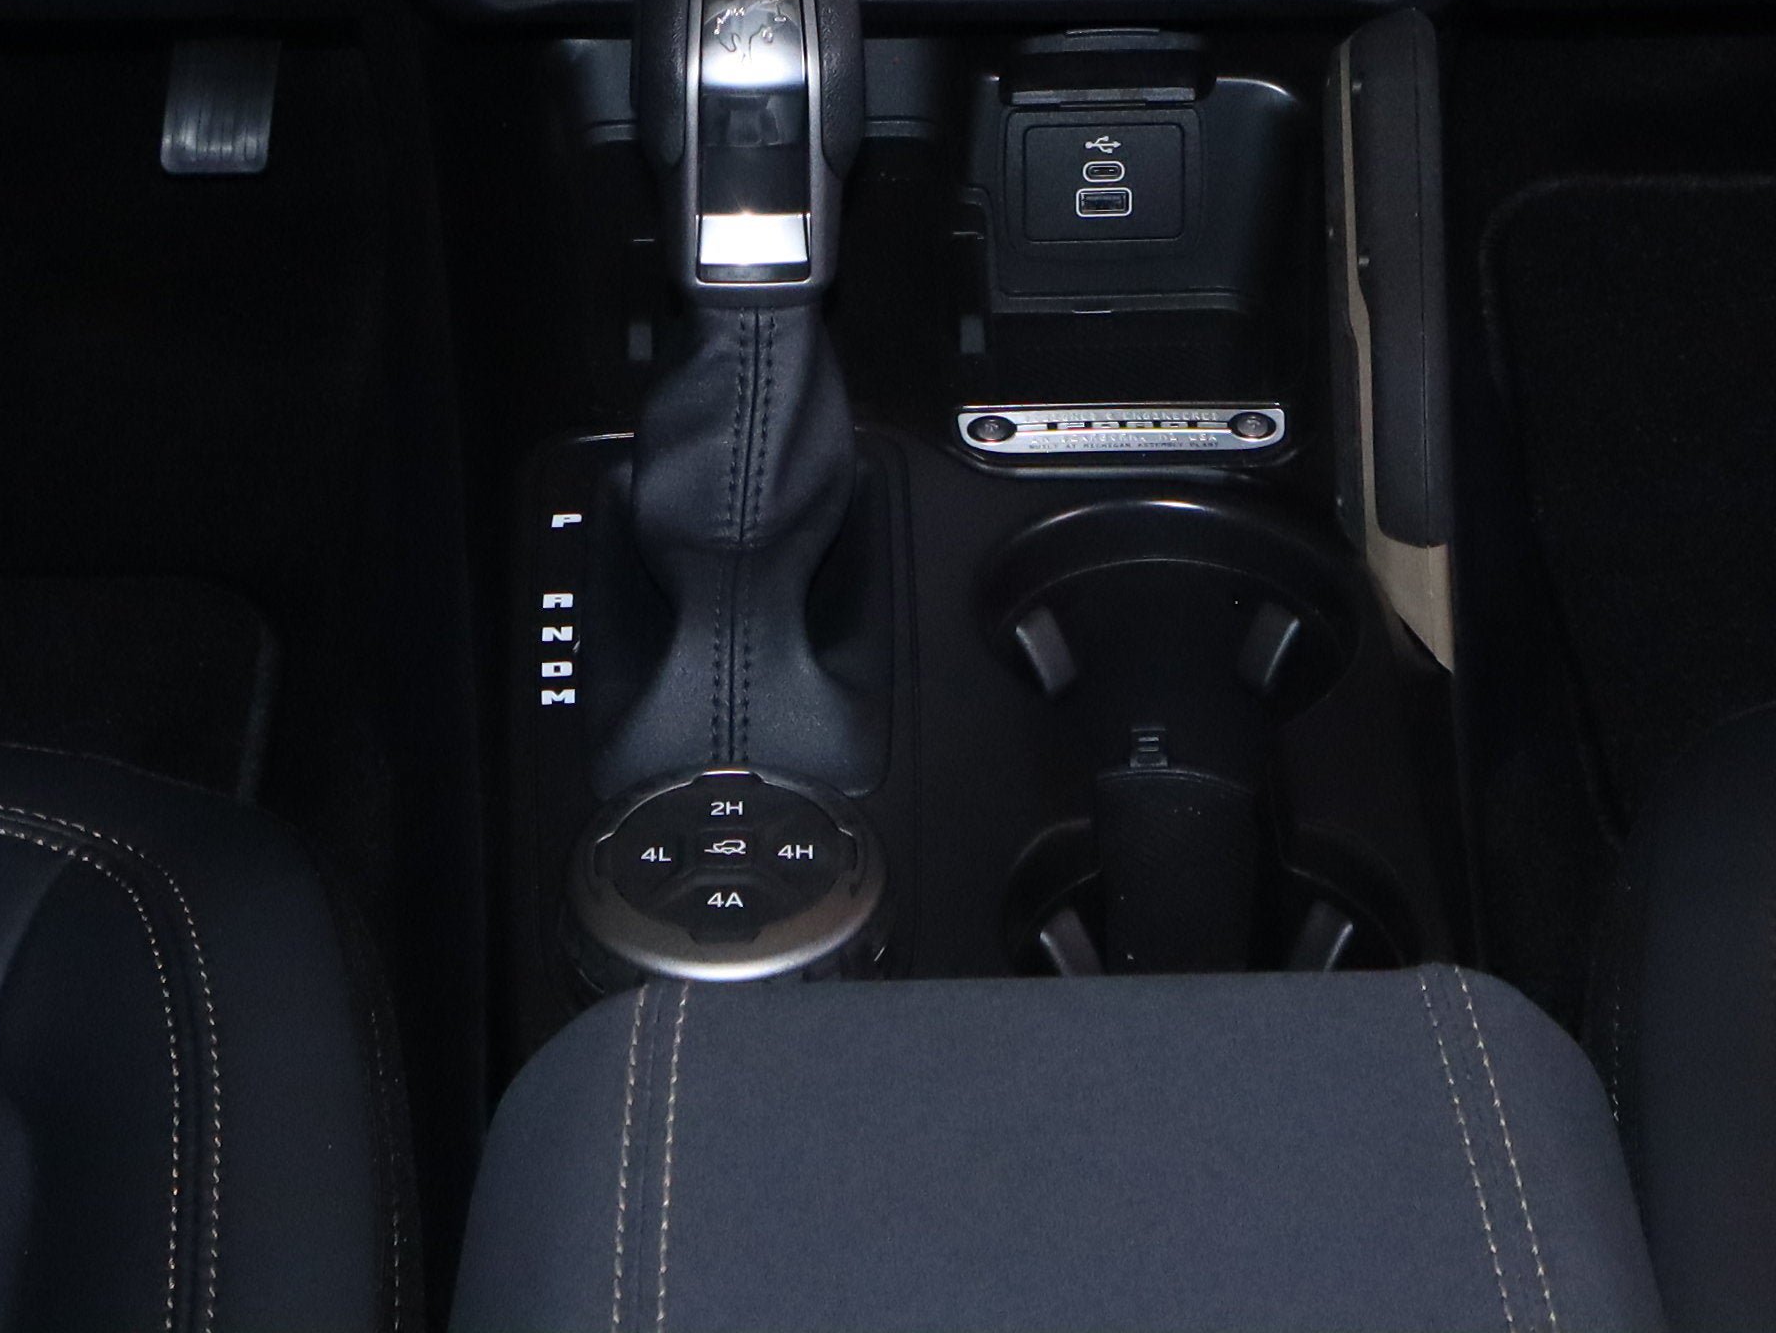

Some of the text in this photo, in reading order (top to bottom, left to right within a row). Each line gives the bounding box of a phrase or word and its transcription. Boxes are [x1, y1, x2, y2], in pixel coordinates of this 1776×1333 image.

[550, 512, 583, 529] P
[541, 625, 574, 643] N
[541, 661, 574, 678] D
[540, 688, 576, 706] M
[709, 800, 744, 817] 2H
[640, 844, 815, 864] 4L 4H
[706, 892, 744, 909] 4A
